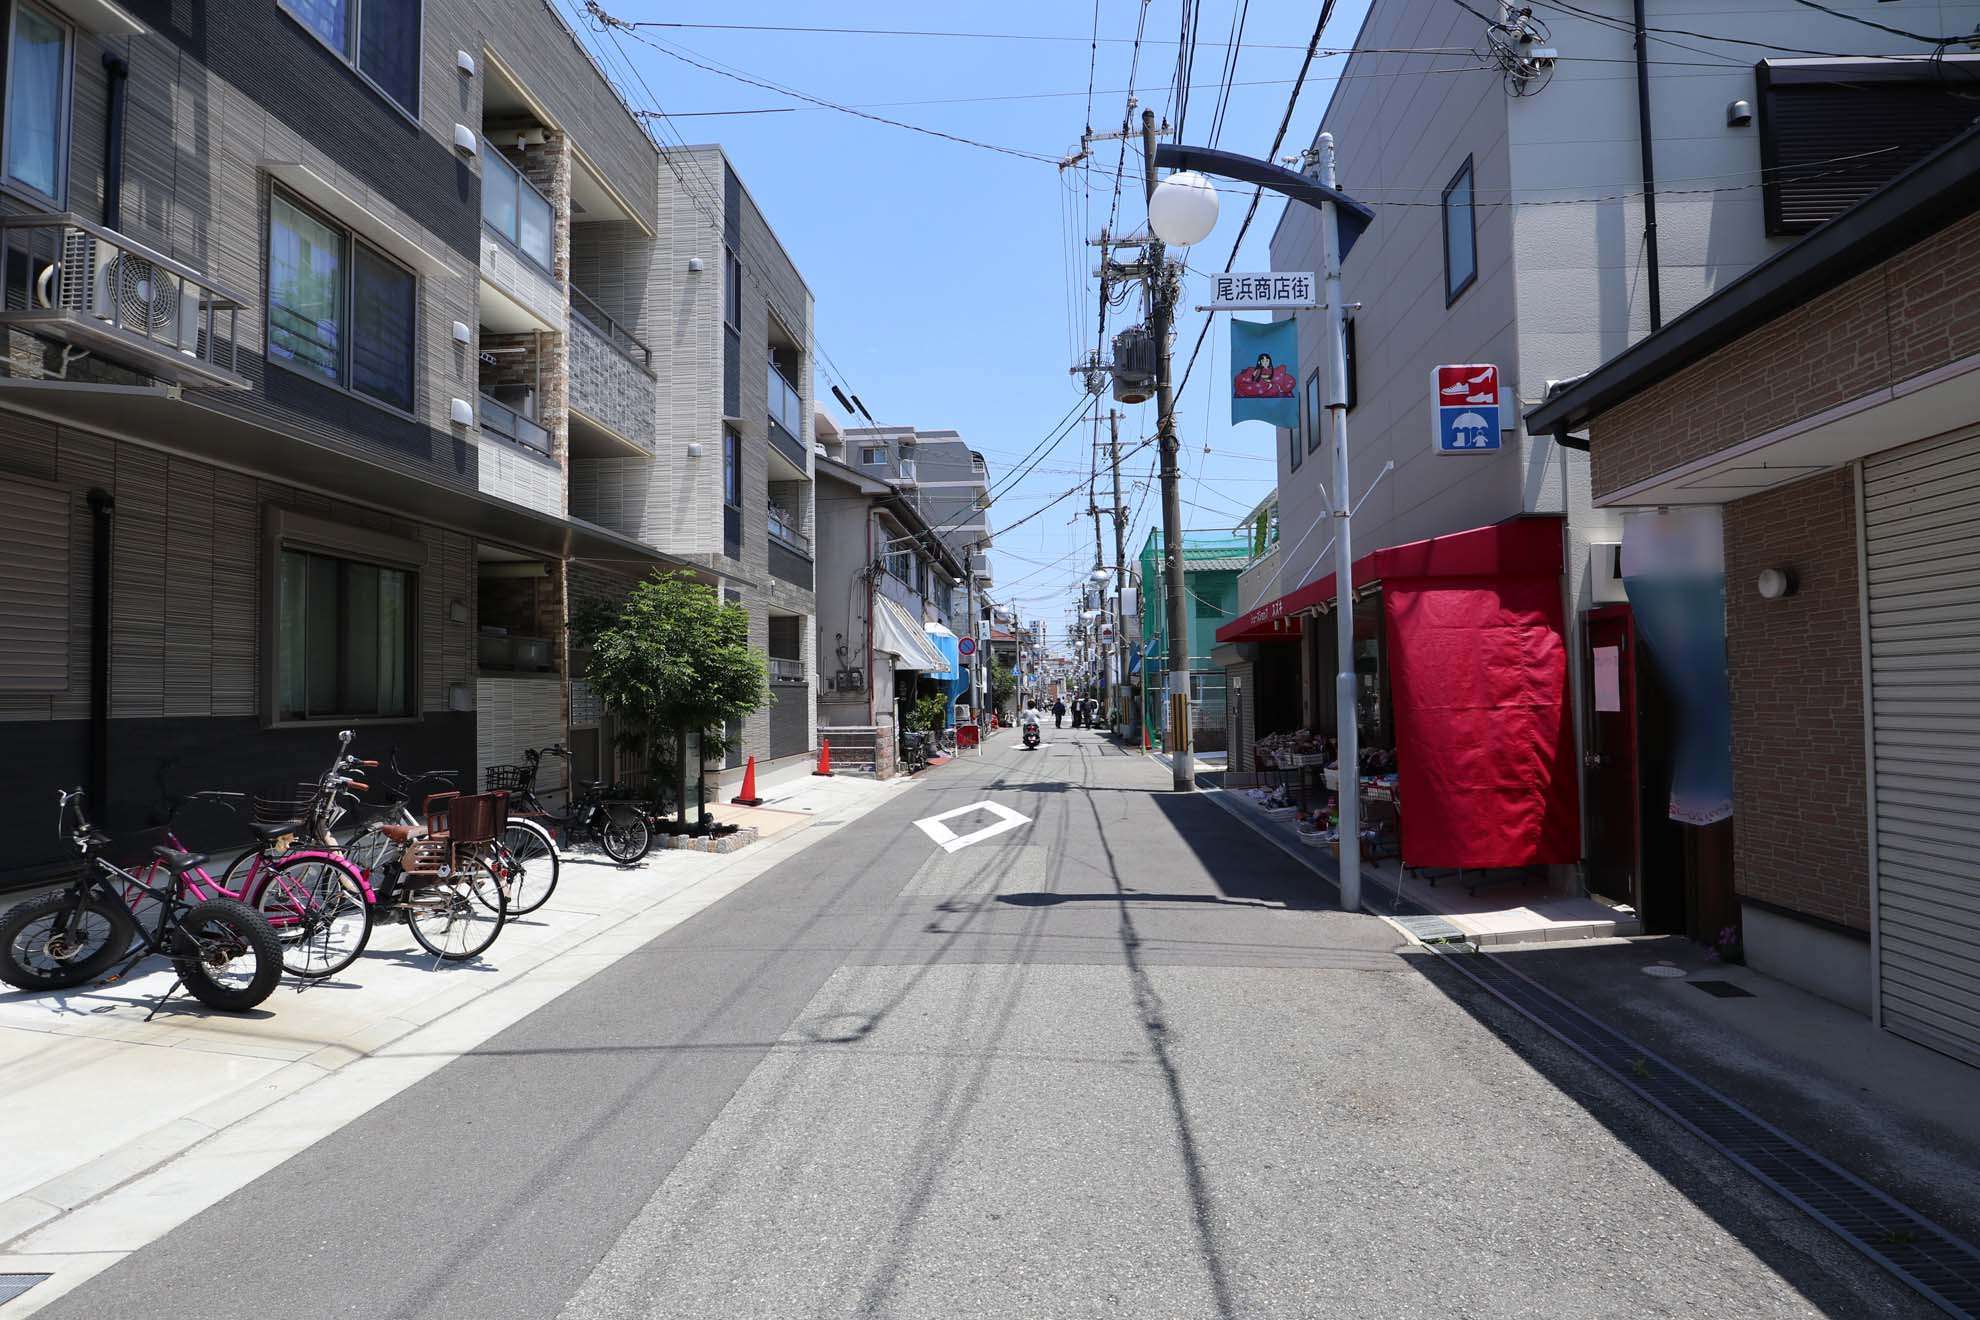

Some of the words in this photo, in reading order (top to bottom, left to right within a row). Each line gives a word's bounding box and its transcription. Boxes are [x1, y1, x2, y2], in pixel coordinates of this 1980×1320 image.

[1216, 276, 1309, 301] 尾浜商店街
